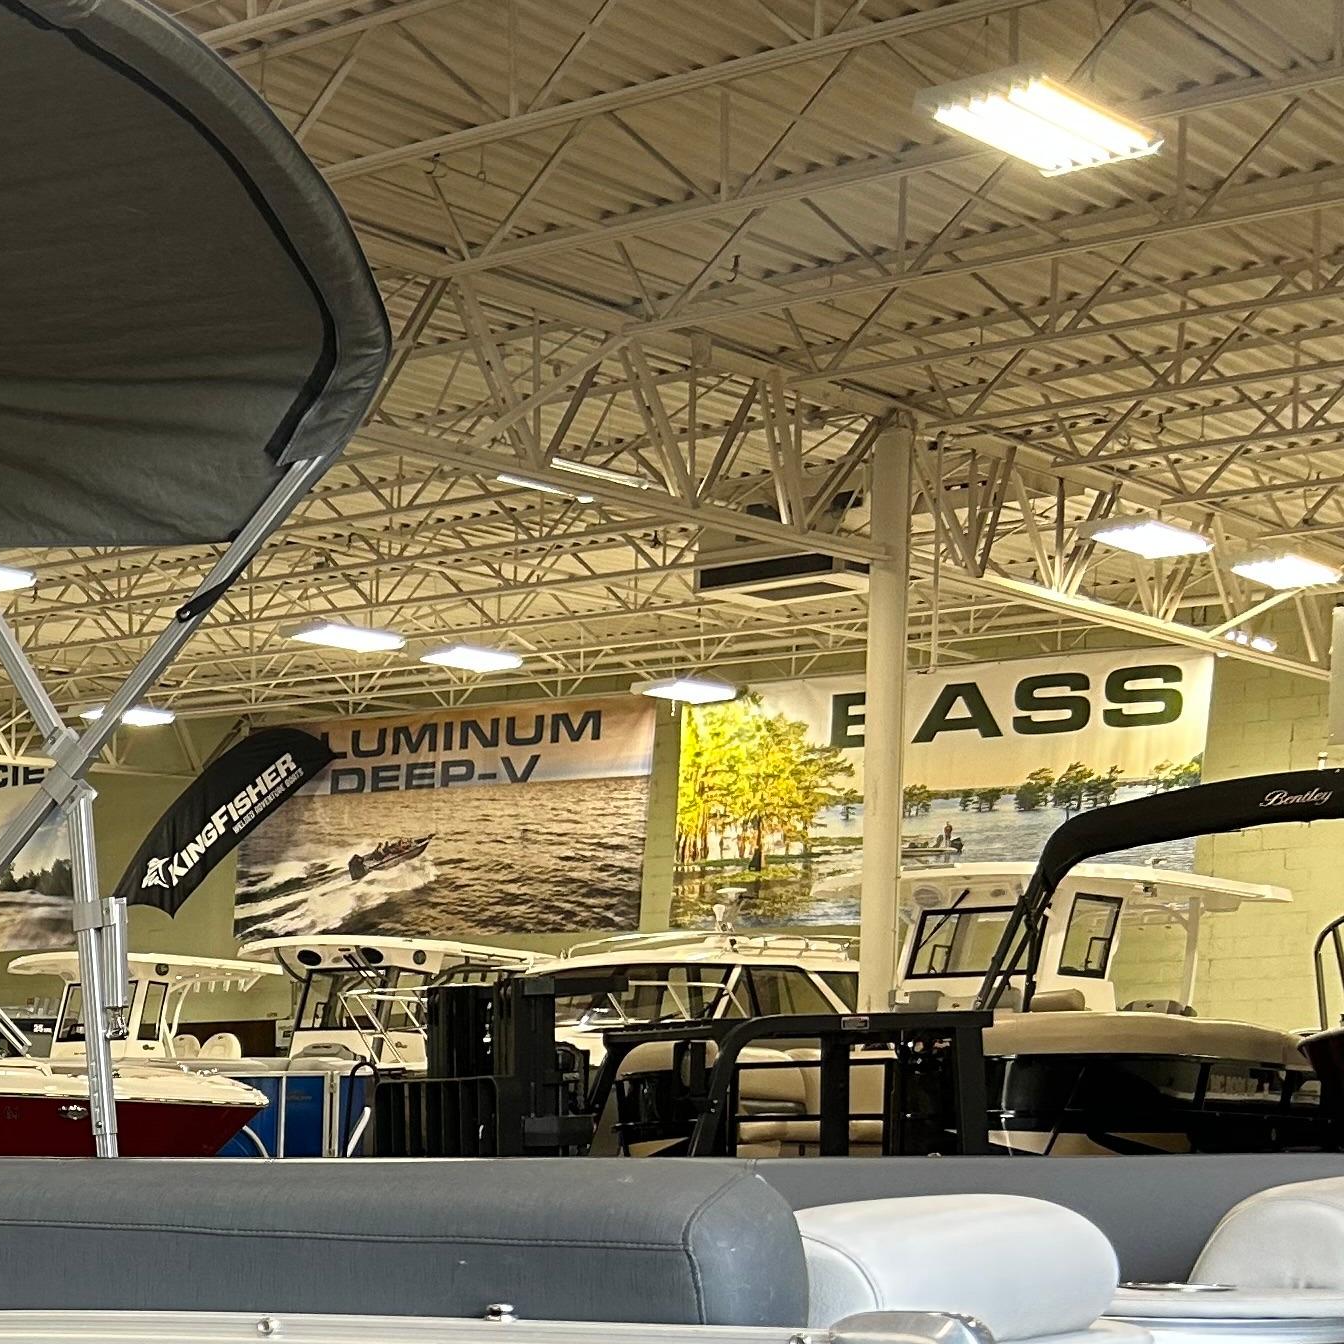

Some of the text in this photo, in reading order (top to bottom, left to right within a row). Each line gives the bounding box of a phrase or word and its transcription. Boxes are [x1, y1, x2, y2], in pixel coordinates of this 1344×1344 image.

[320, 710, 602, 760] LUMINUM
[330, 754, 541, 796] DEEP-V
[1258, 786, 1334, 808] Bentley
[167, 751, 298, 888] KINGFISHER
